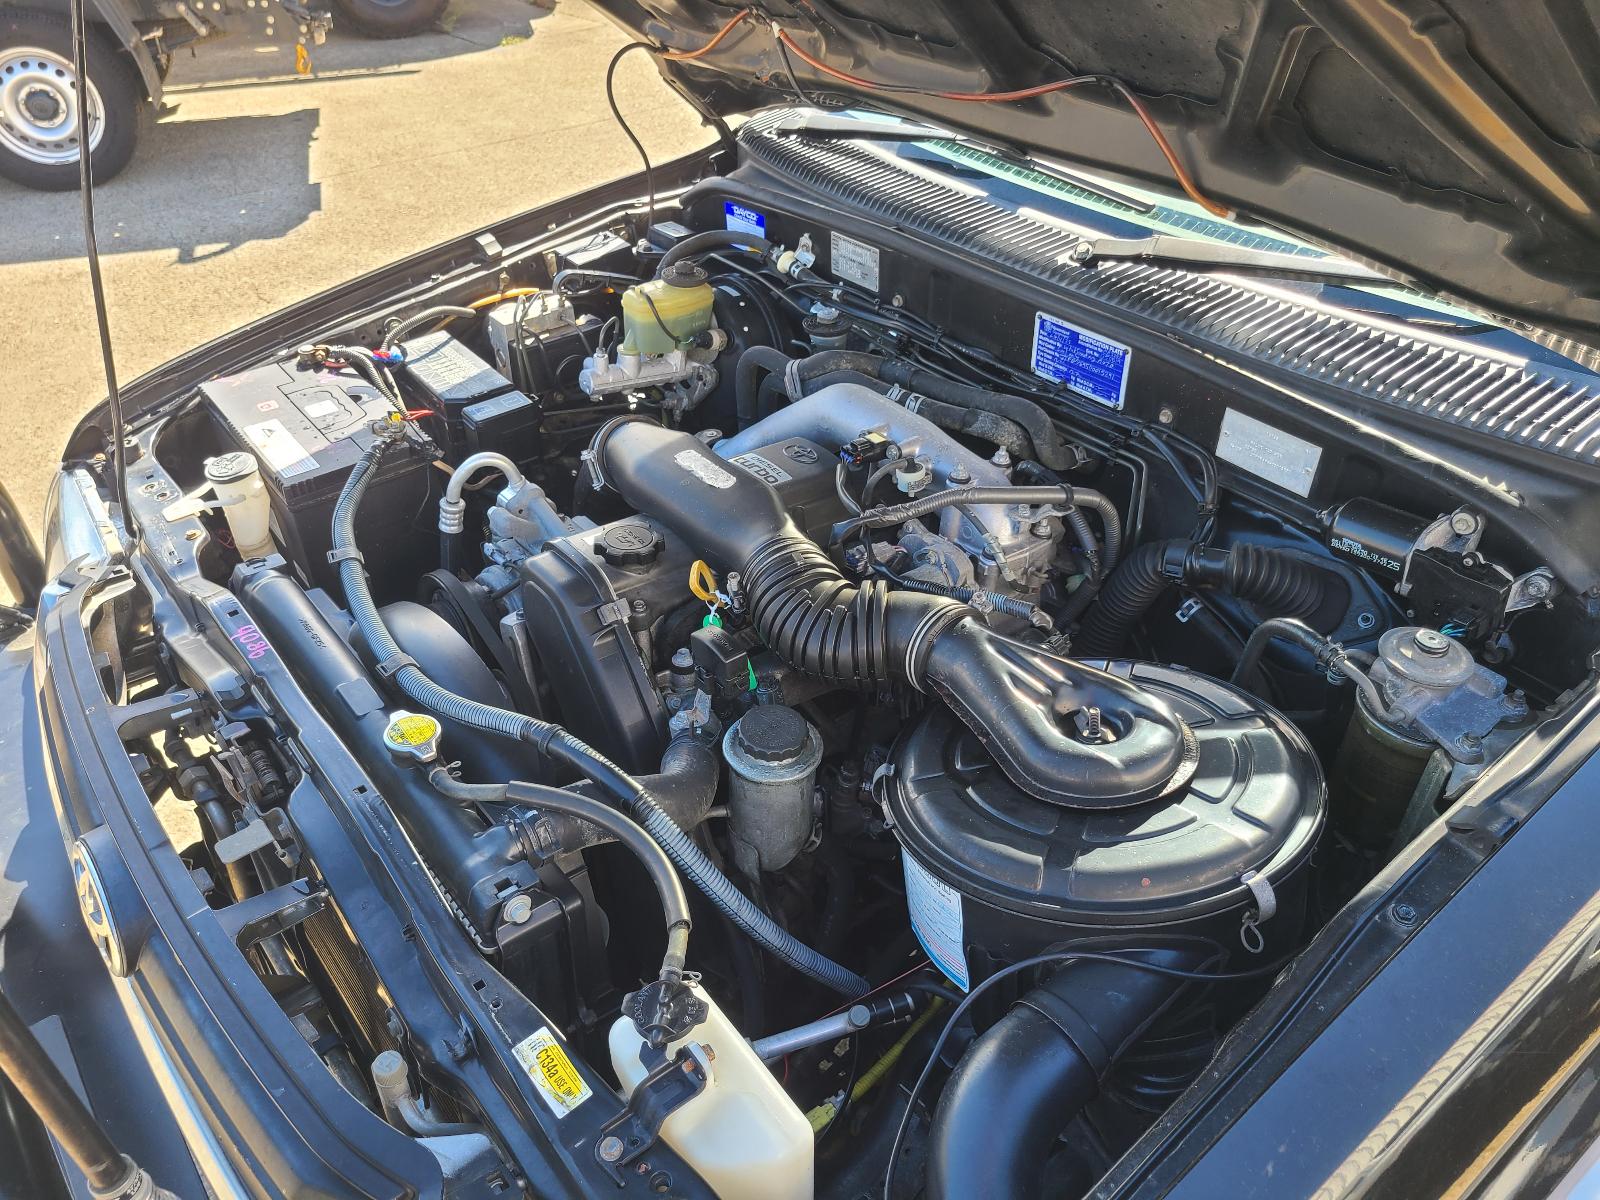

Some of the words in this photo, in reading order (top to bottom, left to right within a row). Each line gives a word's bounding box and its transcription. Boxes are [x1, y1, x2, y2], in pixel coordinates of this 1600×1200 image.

[732, 205, 758, 222] DAYCO
[750, 456, 782, 478] DIESEL
[554, 1075, 568, 1091] USE
